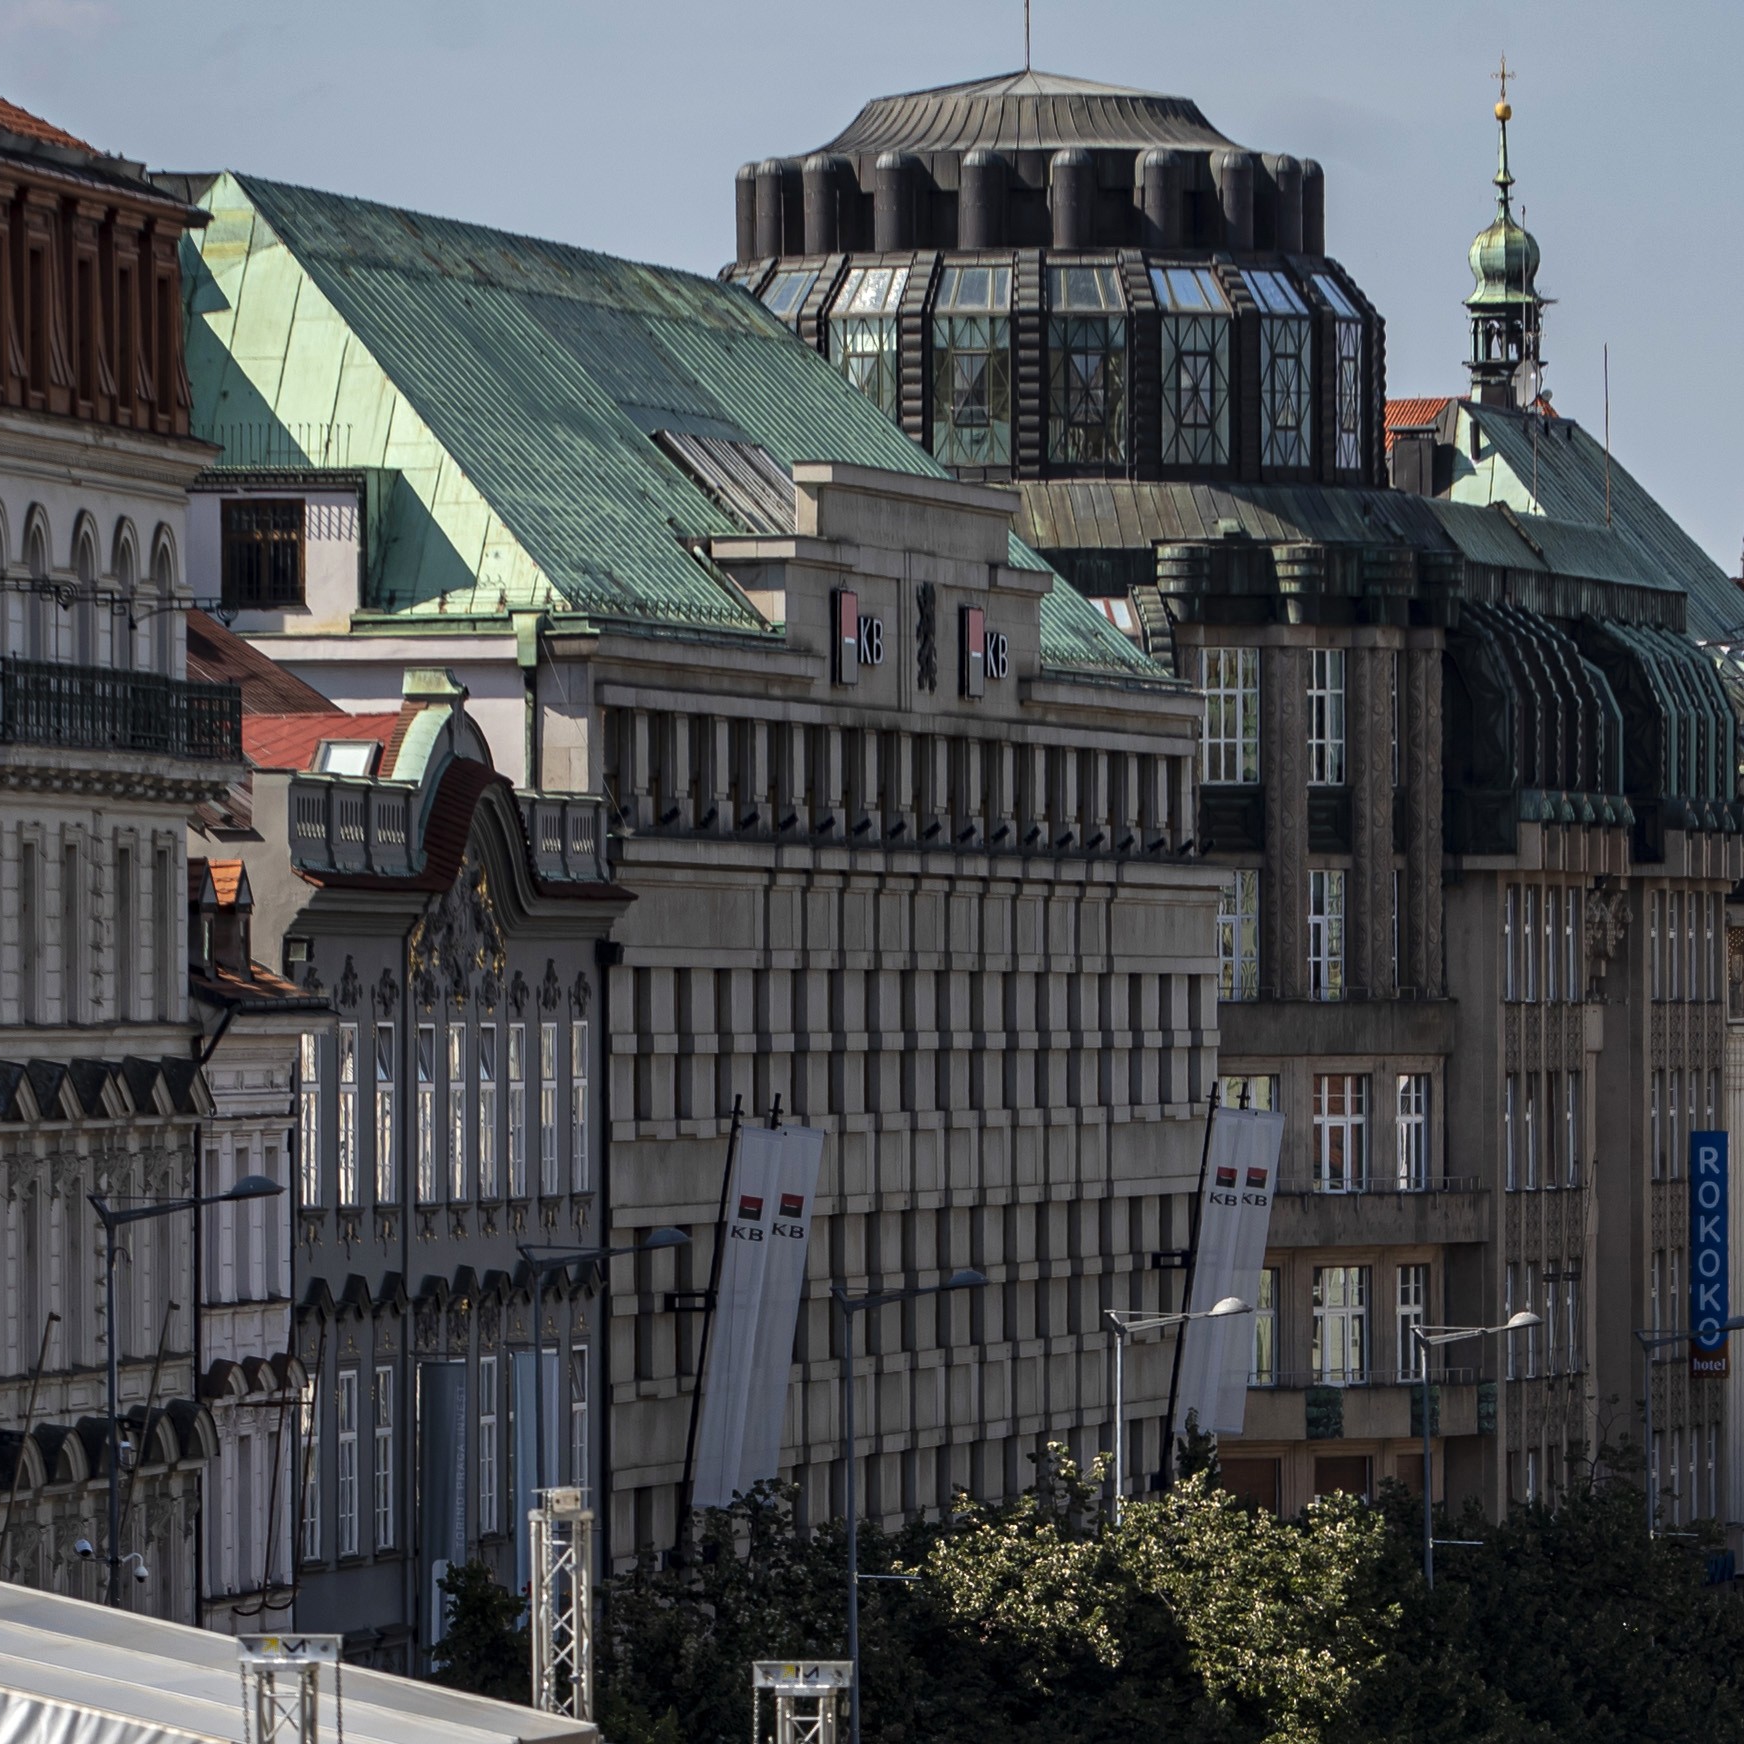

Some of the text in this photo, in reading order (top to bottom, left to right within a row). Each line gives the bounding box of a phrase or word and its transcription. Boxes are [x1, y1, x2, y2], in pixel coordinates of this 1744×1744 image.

[860, 616, 884, 664] KB
[986, 633, 1009, 678] KB
[1209, 1192, 1237, 1207] KB
[1242, 1193, 1267, 1207] KB
[731, 1226, 764, 1242] KB
[772, 1222, 804, 1239] KB
[1698, 1146, 1720, 1346] ROKOKO
[1693, 1358, 1727, 1371] hotel
